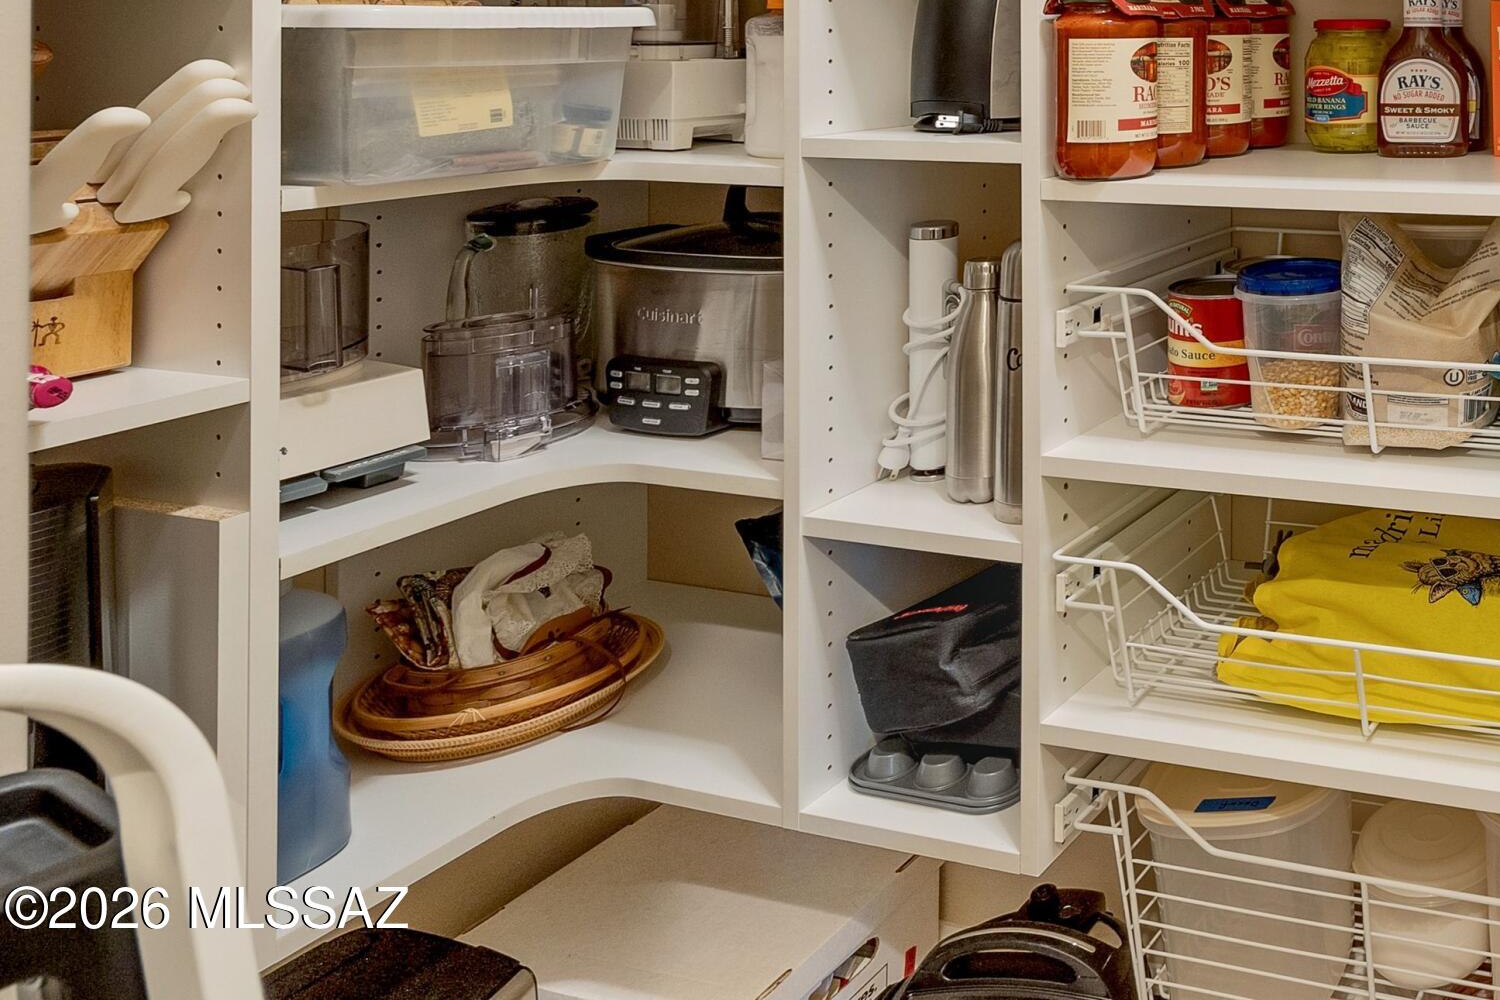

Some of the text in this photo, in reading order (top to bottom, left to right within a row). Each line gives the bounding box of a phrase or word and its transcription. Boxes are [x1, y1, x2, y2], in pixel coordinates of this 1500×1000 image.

[1307, 75, 1344, 89] Mezzetta
[1397, 75, 1441, 90] RAY'S
[1393, 90, 1445, 101] NO SUGAR ADDED
[1384, 106, 1414, 114] SWEET
[1424, 106, 1455, 114] SMOKY
[637, 307, 704, 325] Cuisinart
[1181, 350, 1216, 360] Sauce
